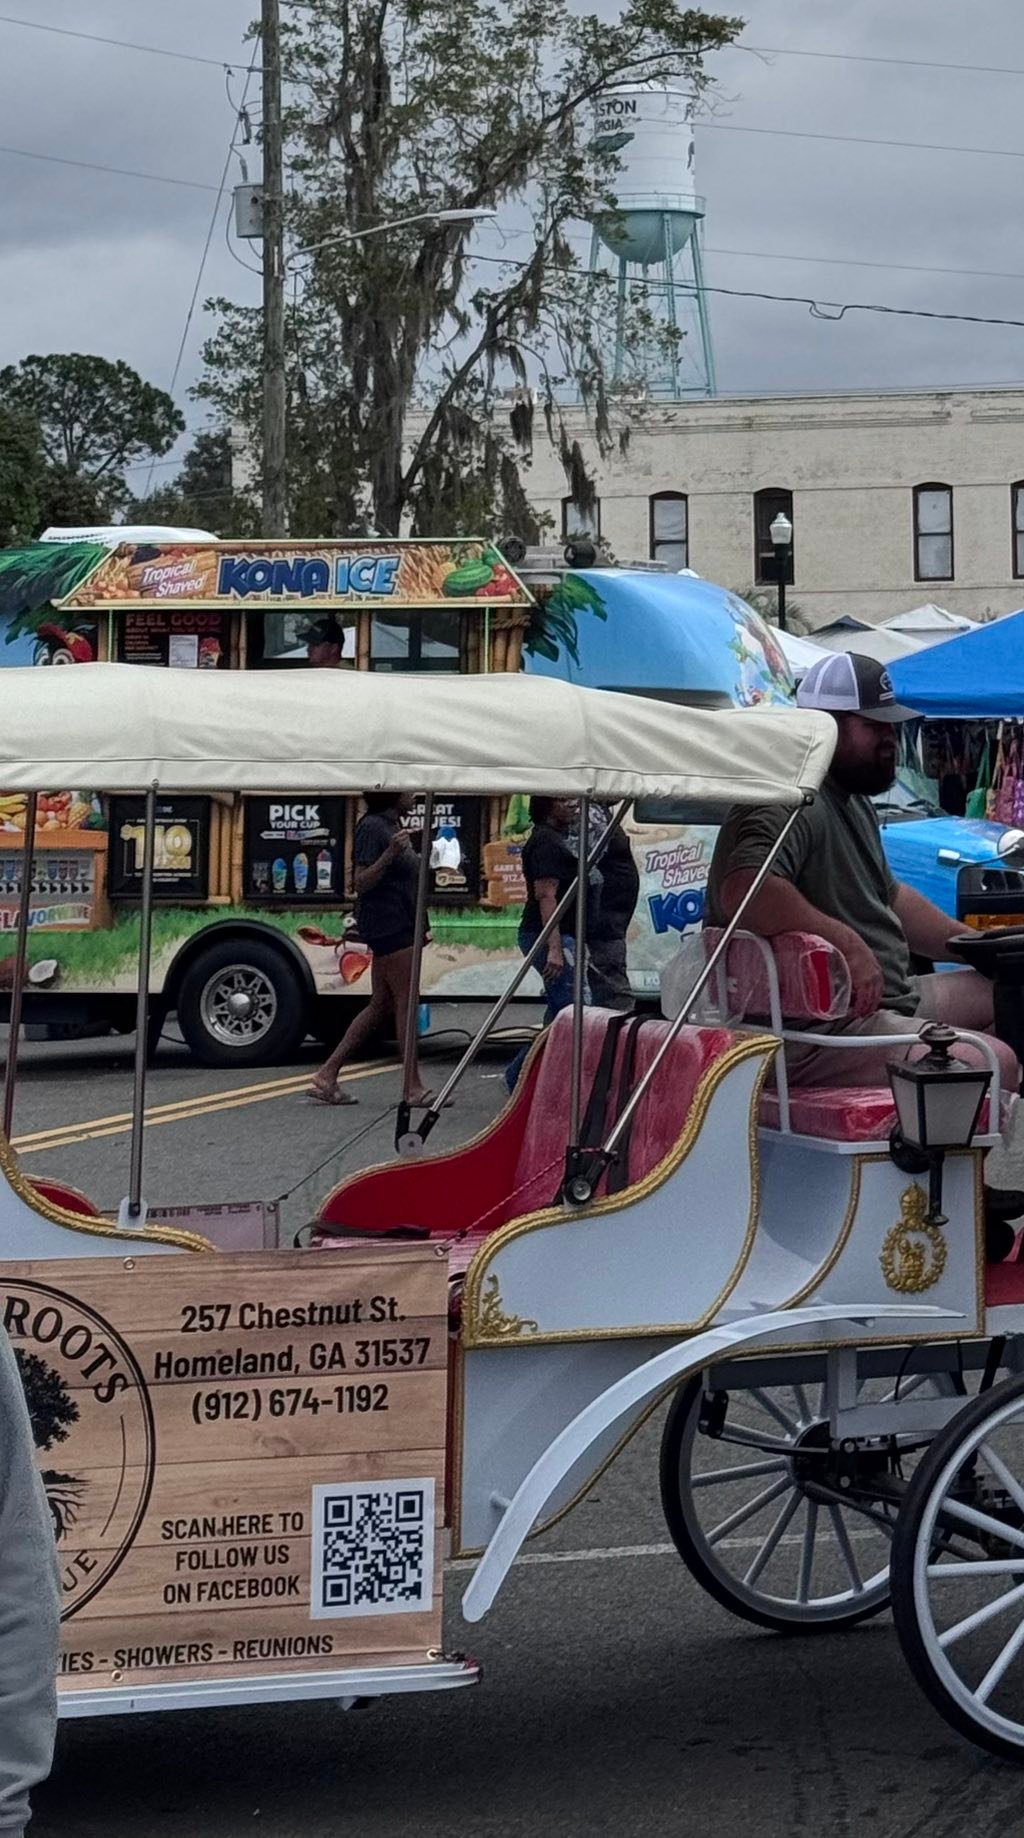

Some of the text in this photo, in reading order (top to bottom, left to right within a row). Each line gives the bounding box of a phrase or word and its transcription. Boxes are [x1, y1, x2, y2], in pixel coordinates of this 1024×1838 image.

[598, 100, 636, 117] STON
[141, 560, 195, 583] Tropical
[155, 573, 208, 597] Shaved
[217, 556, 401, 599] KONA ICE
[125, 612, 221, 626] FEEL GOOD
[269, 804, 320, 821] PICK
[407, 804, 455, 815] RAT
[271, 821, 321, 829] YOUR CUP
[645, 843, 704, 873] Tropical
[648, 887, 708, 933] KO
[181, 1296, 407, 1333] 257 Chestnut St.
[3, 1296, 130, 1403] ROOTS
[154, 1337, 431, 1379] Homeland, GA 31537
[192, 1384, 389, 1424] (912) 674-1192
[160, 1512, 304, 1540] SCAN HERE TO
[62, 1550, 98, 1592] UE
[176, 1545, 290, 1571] FOLLOW US
[163, 1575, 301, 1604] ON FACEBOOK
[60, 1651, 94, 1672] IES
[113, 1642, 214, 1669] SHOWERS
[232, 1635, 334, 1661] REUNIONS
